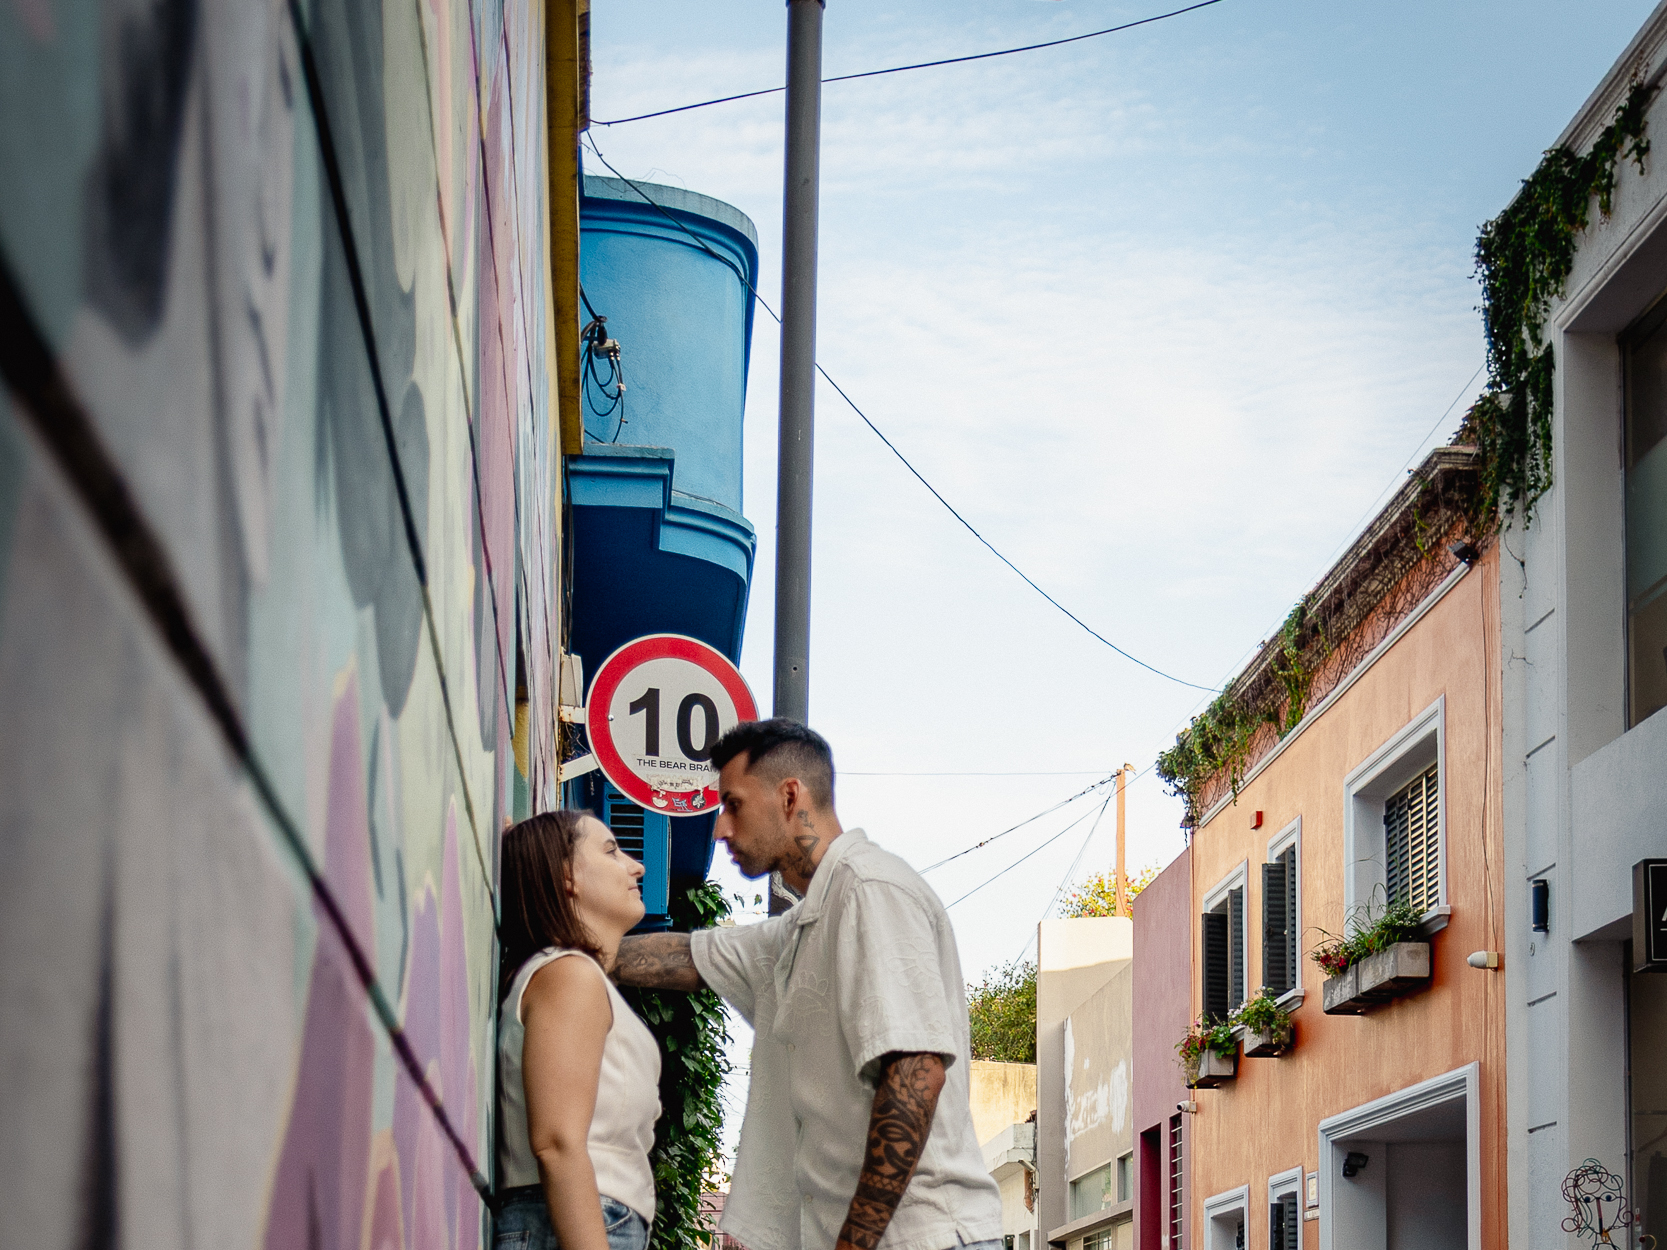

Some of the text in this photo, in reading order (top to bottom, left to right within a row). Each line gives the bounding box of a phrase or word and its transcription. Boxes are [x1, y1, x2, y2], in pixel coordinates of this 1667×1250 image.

[629, 687, 719, 762] 10
[637, 759, 657, 768] THE
[660, 761, 686, 770] BEAR
